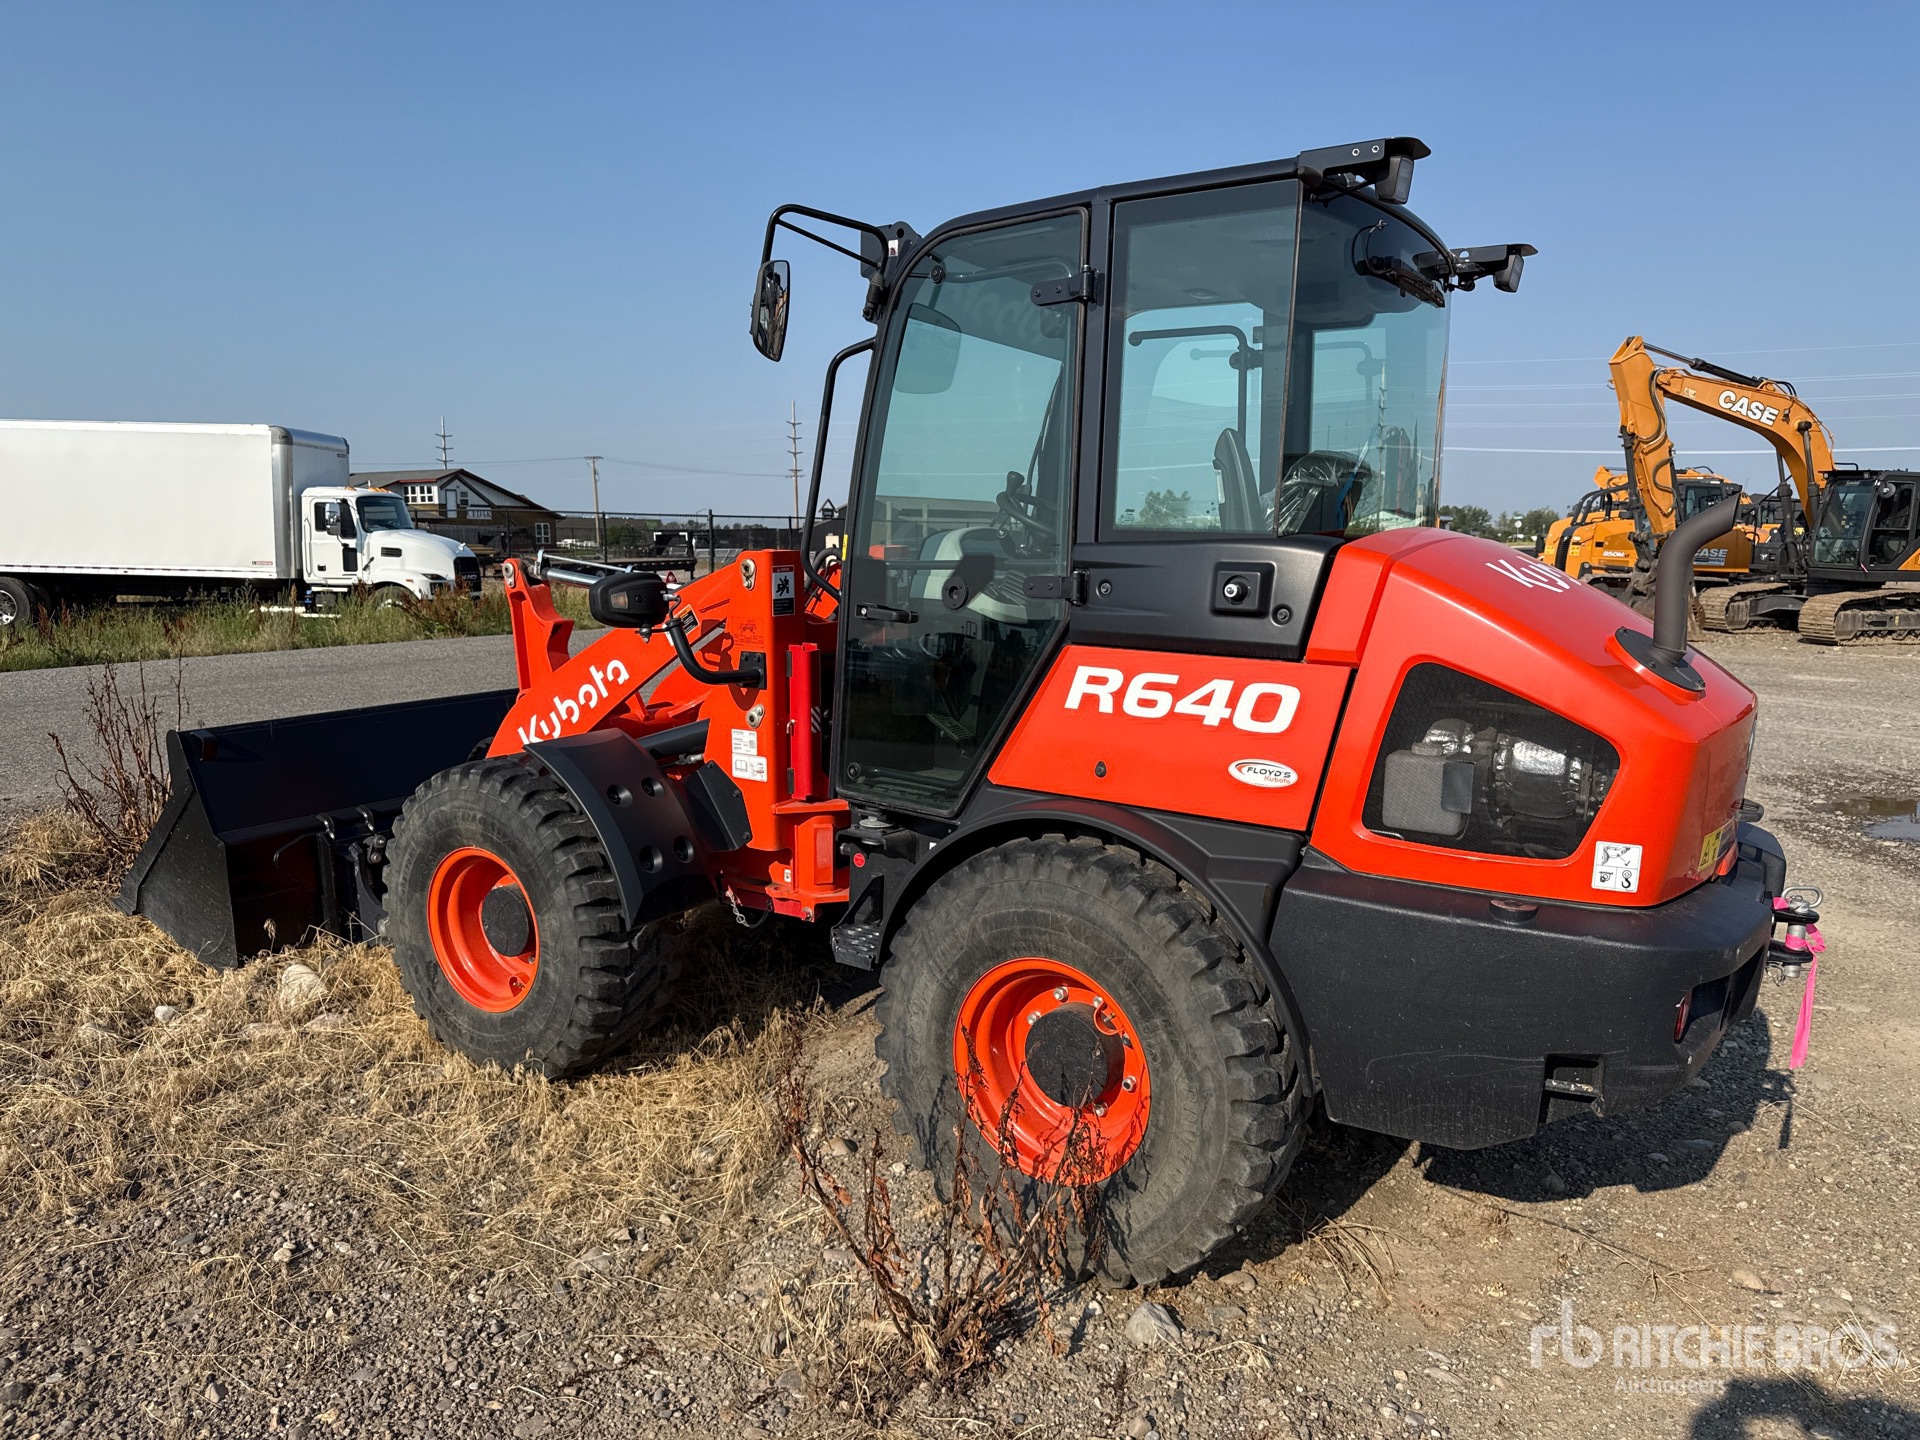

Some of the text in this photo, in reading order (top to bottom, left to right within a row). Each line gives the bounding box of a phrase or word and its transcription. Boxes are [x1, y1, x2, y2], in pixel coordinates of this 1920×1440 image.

[1718, 389, 1780, 426] CASE
[517, 658, 630, 746] Kubota
[1063, 665, 1301, 734] R640
[1246, 766, 1292, 778] FLOYD'S
[1264, 775, 1291, 784] Kubota
